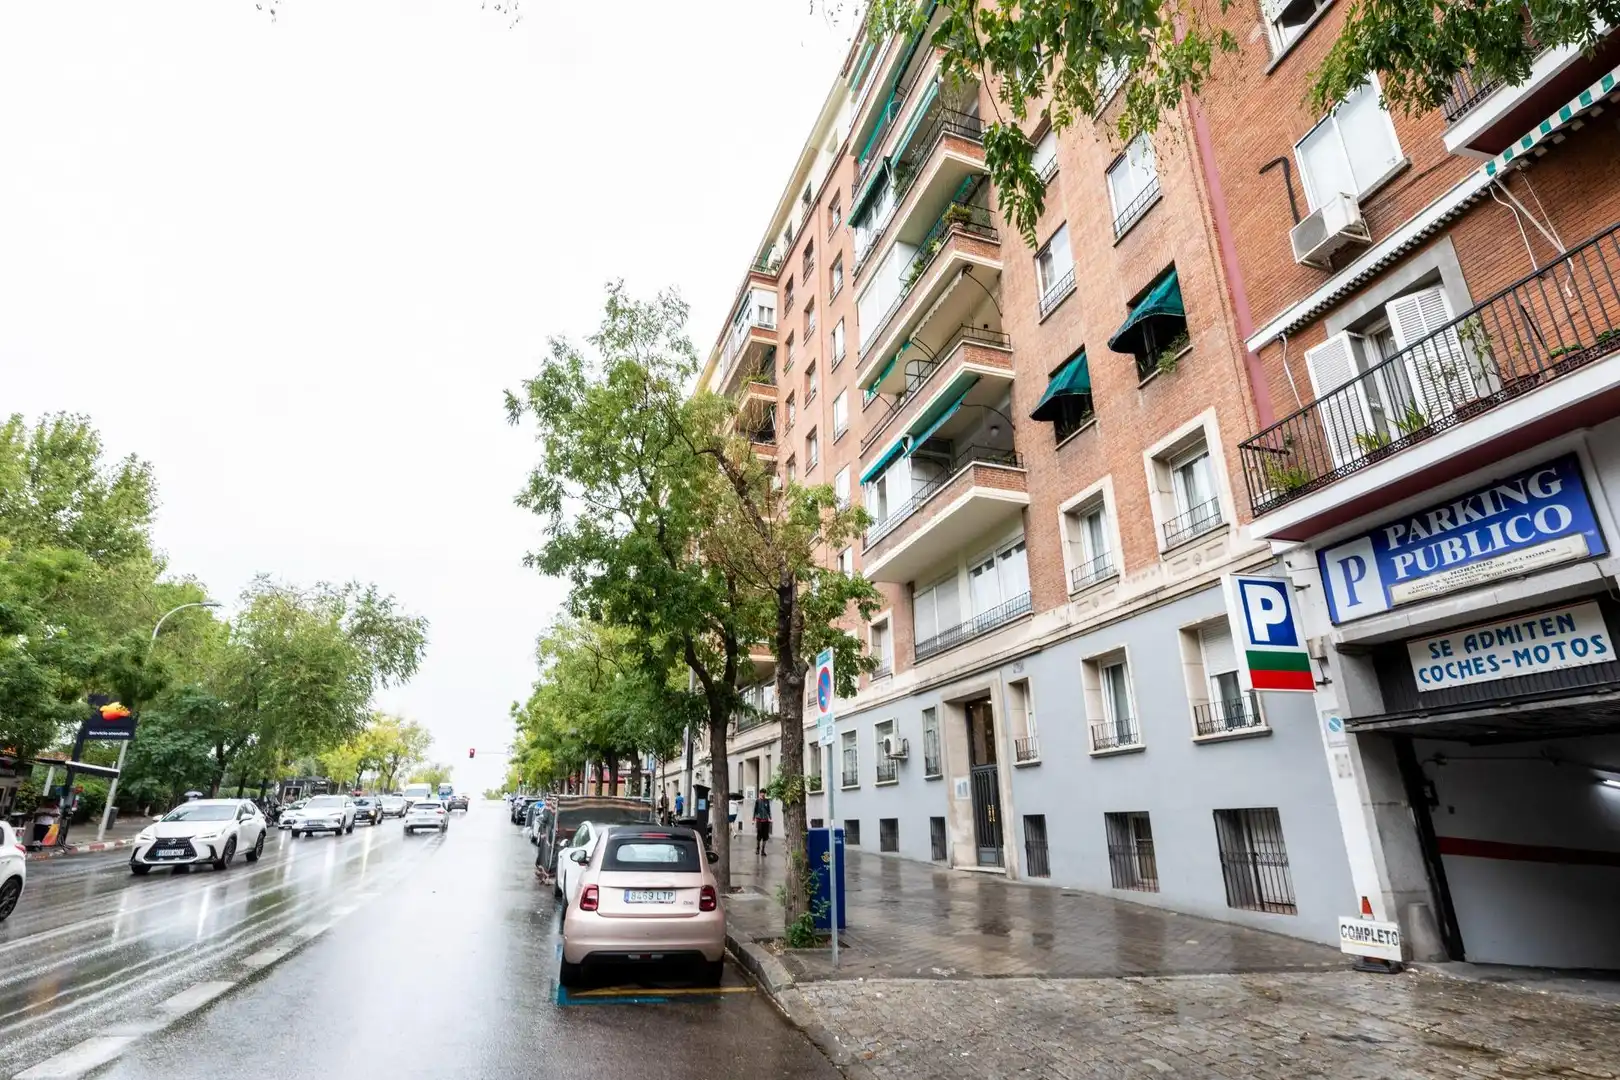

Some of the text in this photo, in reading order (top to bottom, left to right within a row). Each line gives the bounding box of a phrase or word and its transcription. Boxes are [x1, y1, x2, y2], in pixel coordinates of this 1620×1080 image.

[1382, 467, 1562, 551] PARKING
[1390, 504, 1572, 581] PUBLICO
[1526, 547, 1556, 559] HORAS
[1337, 554, 1367, 608] P
[1450, 560, 1493, 576] HORARIO
[1243, 584, 1288, 643] P
[1428, 613, 1577, 660] SE ADMITEN
[1418, 634, 1607, 684] COCHES-MOTOS
[656, 891, 674, 900] LTP
[1340, 924, 1399, 946] COMPLETO
